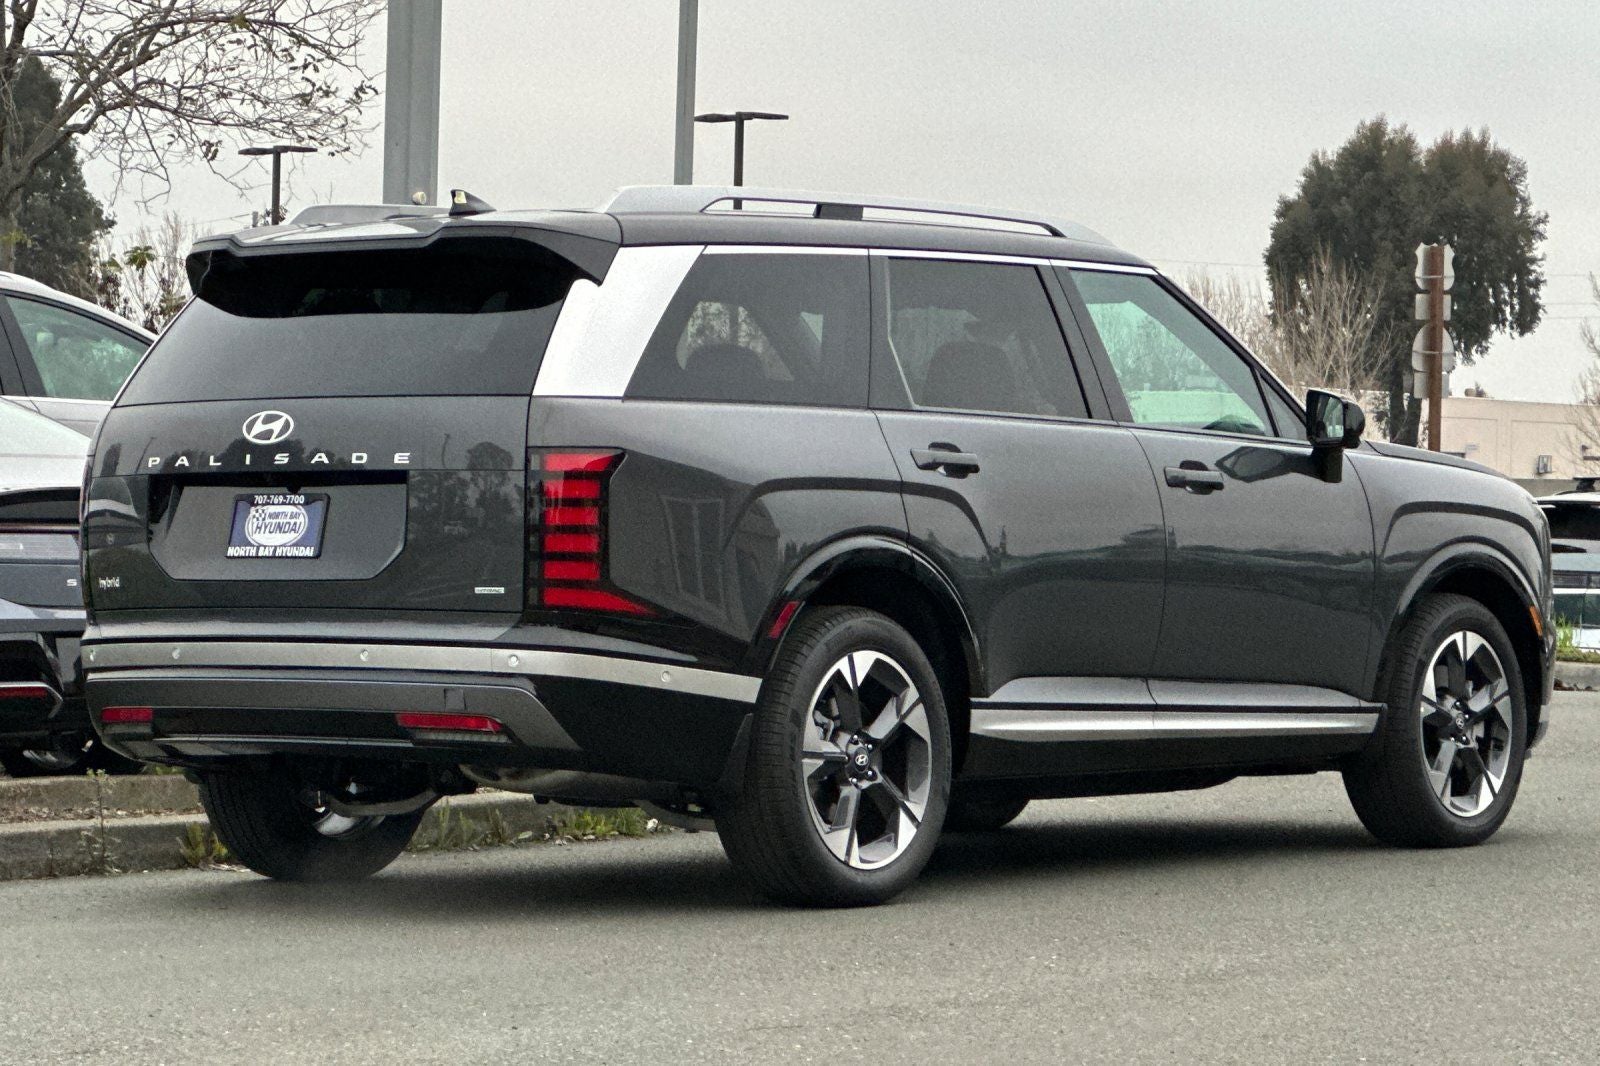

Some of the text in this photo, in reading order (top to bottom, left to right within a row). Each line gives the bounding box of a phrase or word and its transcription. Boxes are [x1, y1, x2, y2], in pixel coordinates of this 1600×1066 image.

[148, 452, 411, 468] PALISADE
[254, 495, 305, 504] 707-769-7700
[267, 511, 301, 520] NORTH BAY
[255, 521, 302, 534] HYUNDAI
[227, 546, 315, 557] NORTH BAY HYUNDAI
[98, 576, 120, 590] hybrid
